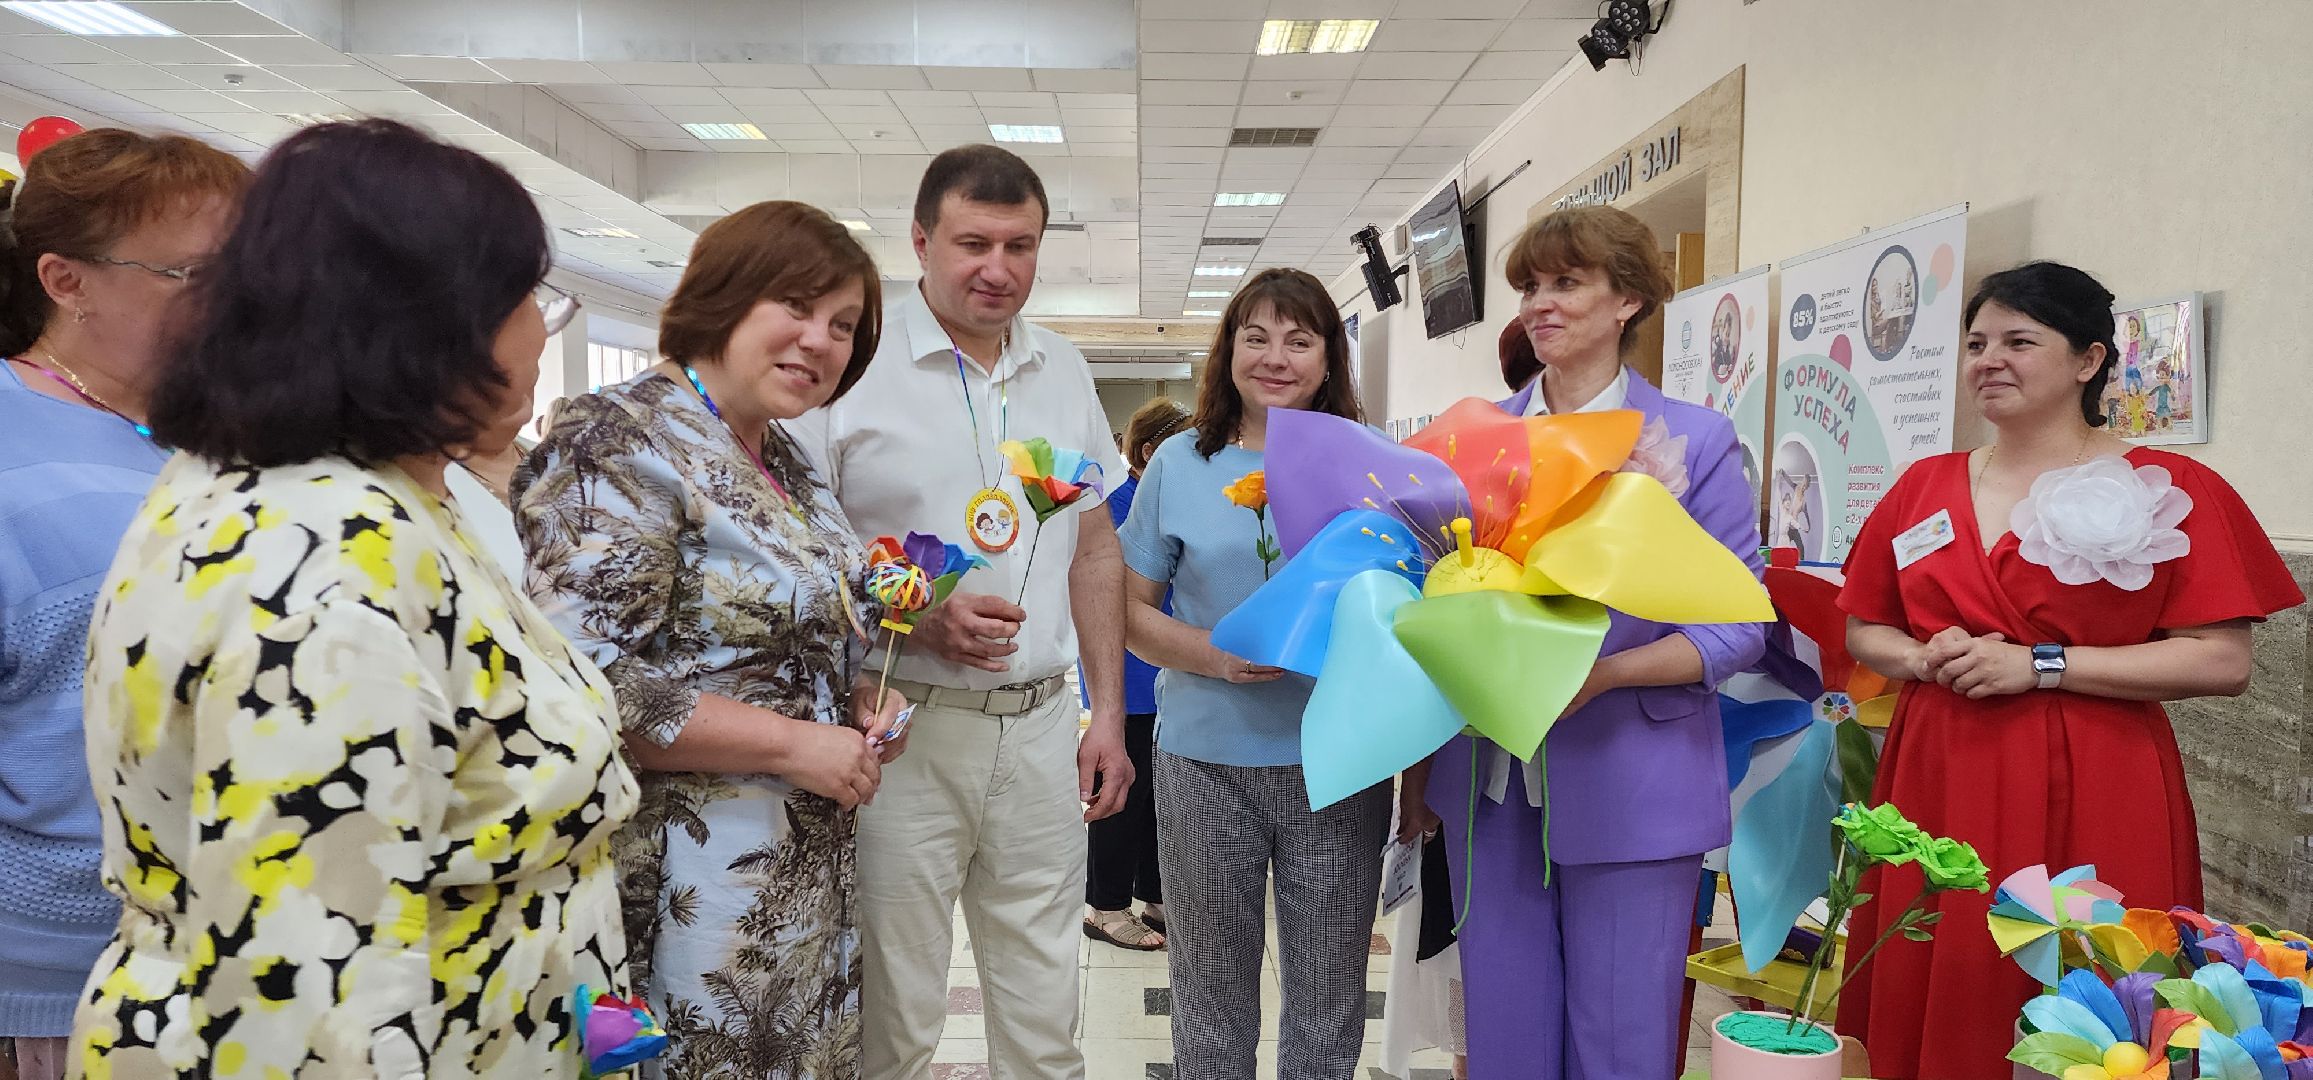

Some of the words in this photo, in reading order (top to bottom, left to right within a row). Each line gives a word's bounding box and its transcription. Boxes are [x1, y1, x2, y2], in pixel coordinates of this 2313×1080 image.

[1640, 126, 1681, 182] ЗАЛ
[1793, 309, 1814, 328] 85%
[1784, 364, 1857, 422] ФОРМУЛА
[1793, 394, 1850, 456] УСПЕХА
[1847, 482, 1880, 493] развития
[1848, 463, 1884, 475] Комплекс
